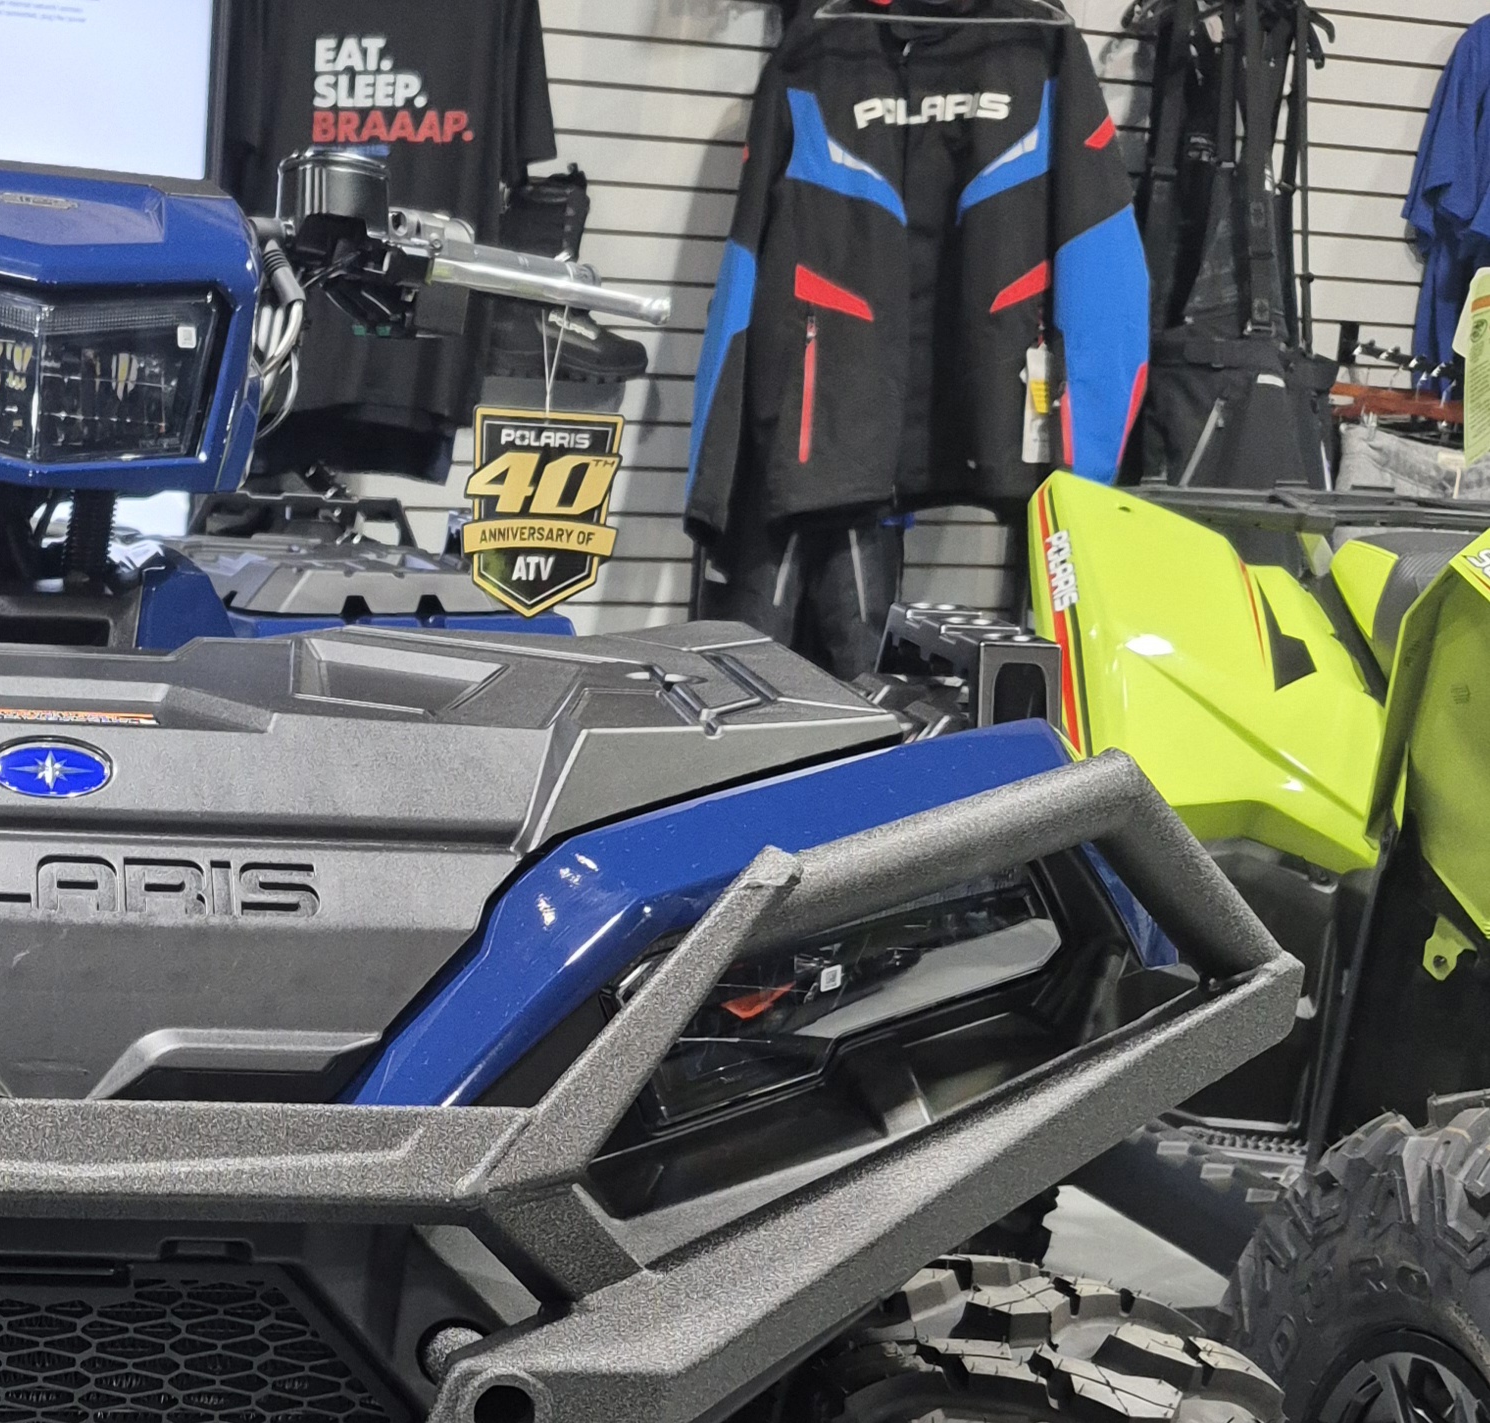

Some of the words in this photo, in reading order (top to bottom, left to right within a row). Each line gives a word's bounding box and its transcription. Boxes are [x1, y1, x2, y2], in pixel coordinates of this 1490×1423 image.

[314, 36, 393, 72] EAT.
[313, 73, 428, 108] SLEEP.
[312, 110, 475, 143] BRAAAP.
[500, 429, 590, 449] POLARIS
[479, 526, 573, 544] ANNIVERSARY
[576, 531, 595, 546] OF
[511, 555, 555, 581] ATV
[1044, 529, 1080, 612] POLARIS
